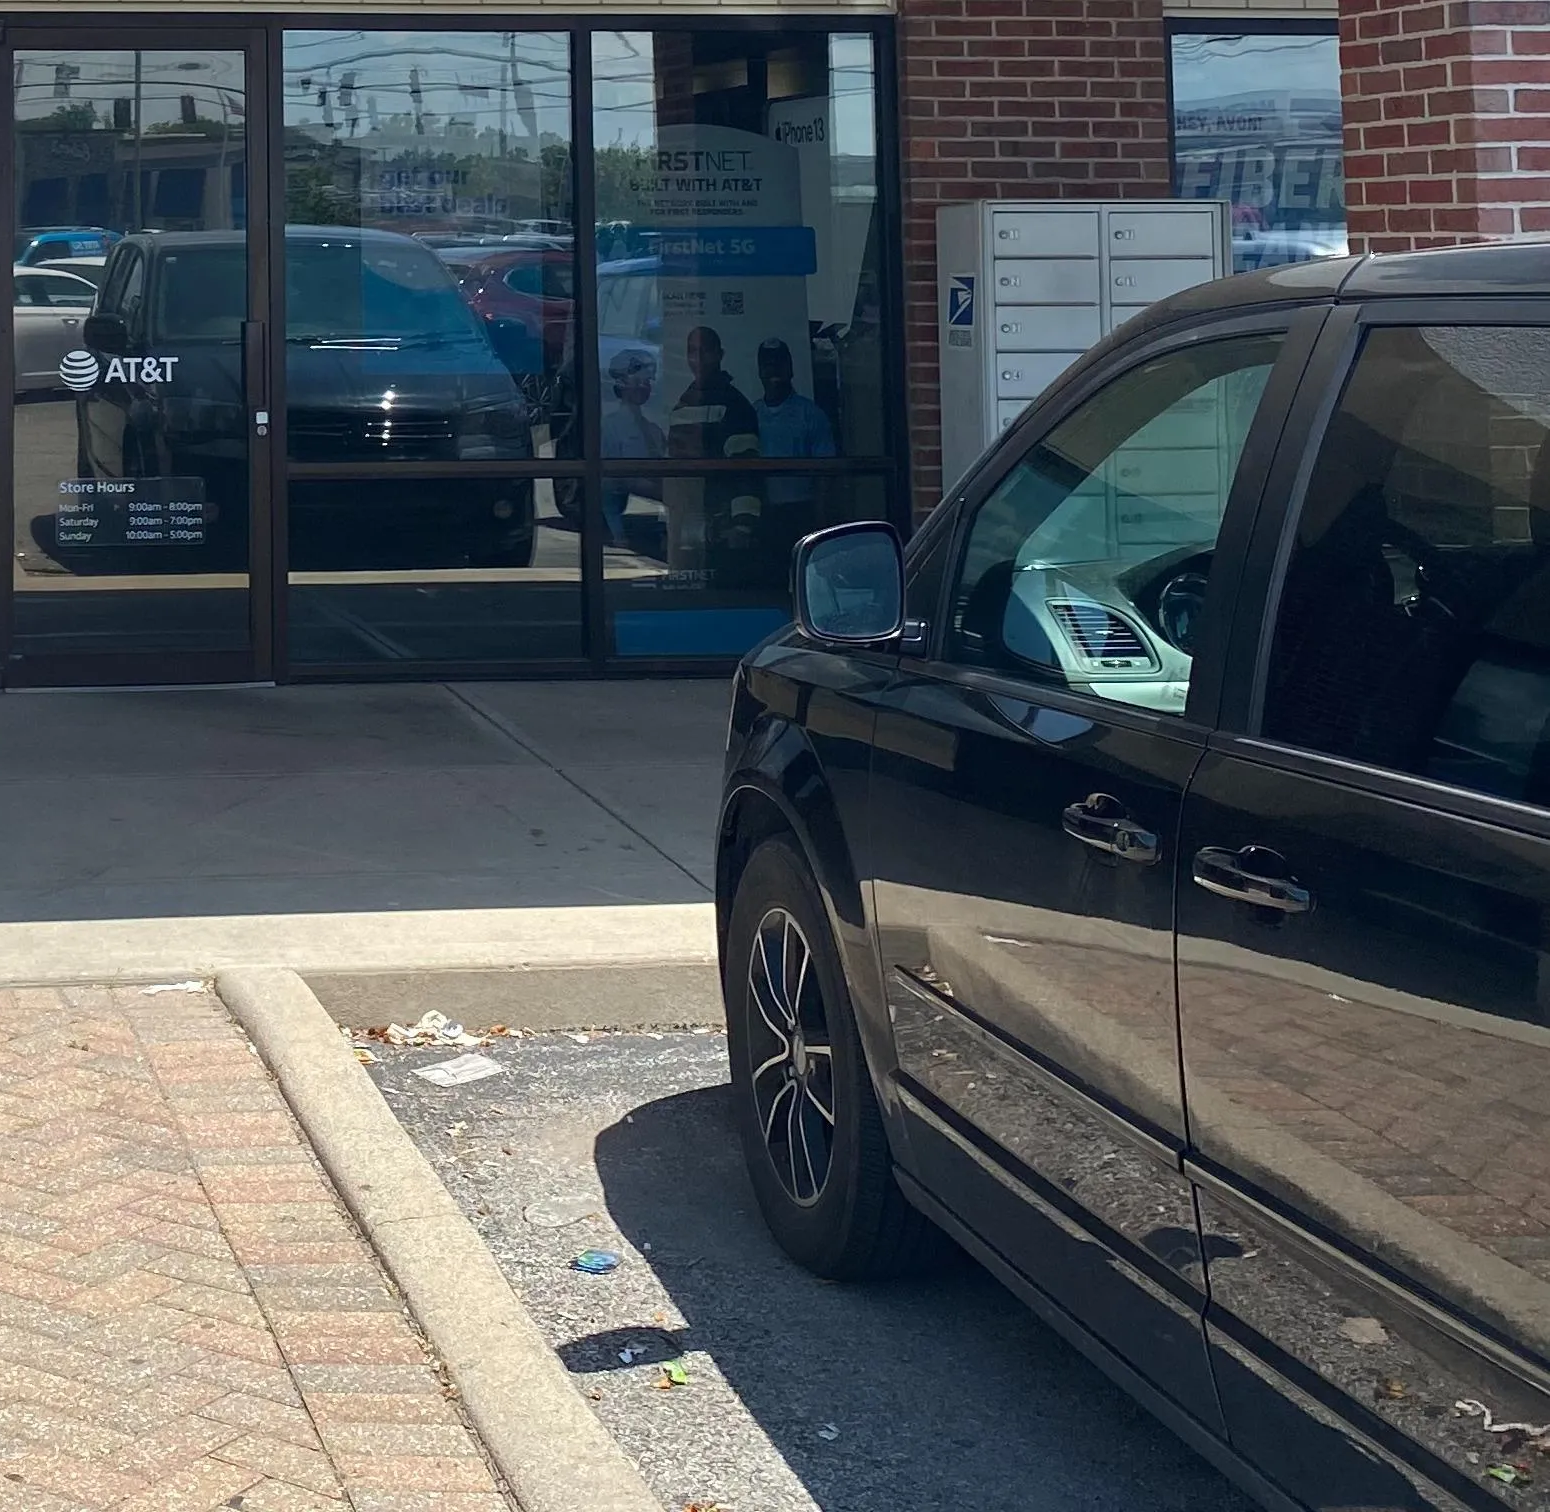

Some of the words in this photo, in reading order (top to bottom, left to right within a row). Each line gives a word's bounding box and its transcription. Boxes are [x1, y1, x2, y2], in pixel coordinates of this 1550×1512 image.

[782, 122, 813, 144] iPhone
[813, 118, 825, 142] 13
[635, 150, 753, 172] FRSTNET
[676, 178, 718, 192] WITH
[721, 178, 763, 192] AT&T
[649, 238, 725, 255] FirstNet
[730, 238, 756, 255] 5G
[105, 356, 179, 383] AT&T
[59, 481, 95, 494] Store
[97, 481, 135, 493] Hours
[59, 503, 94, 512] Mon-Fri
[128, 502, 162, 512] 9:00am
[59, 517, 99, 528] Saturday
[129, 516, 163, 526] 9:00am
[170, 516, 203, 526] 7:00pm
[59, 531, 92, 542] Sunday
[125, 530, 163, 540] 10:00am
[170, 530, 203, 541] 5:00pm
[661, 569, 717, 581] IRSTNET
